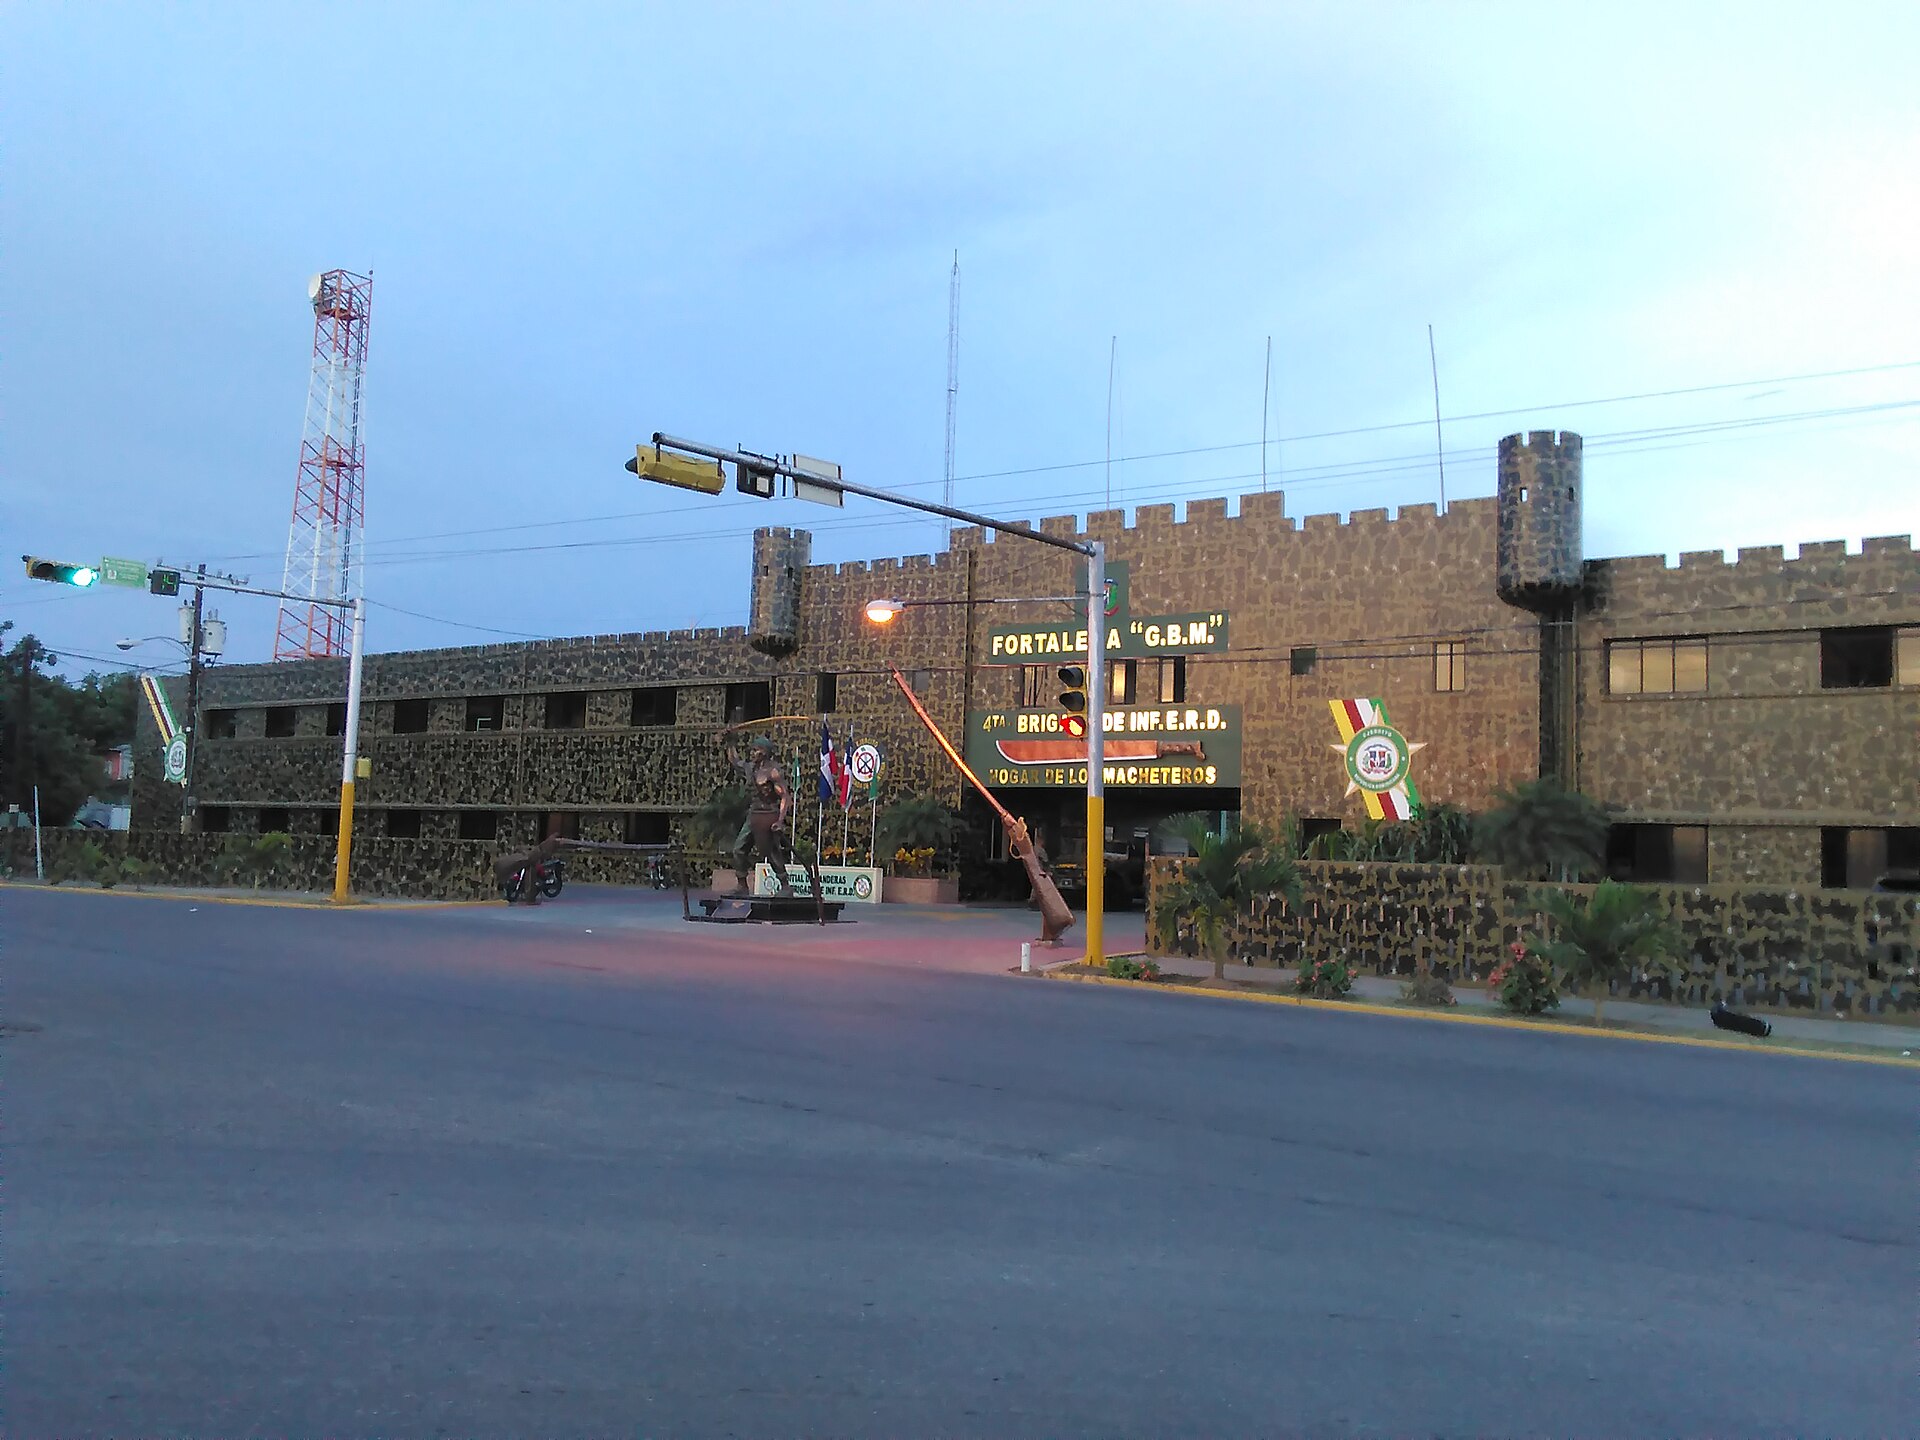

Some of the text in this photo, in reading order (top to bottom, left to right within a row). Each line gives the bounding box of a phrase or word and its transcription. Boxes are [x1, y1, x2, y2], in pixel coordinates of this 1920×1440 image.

[992, 628, 1122, 656] FORTALEA
[1017, 713, 1070, 733] BRIG
[1102, 711, 1125, 732] DE
[1045, 768, 1064, 784] DE
[1069, 767, 1088, 784] LO
[1103, 765, 1217, 785] MACHETEROS
